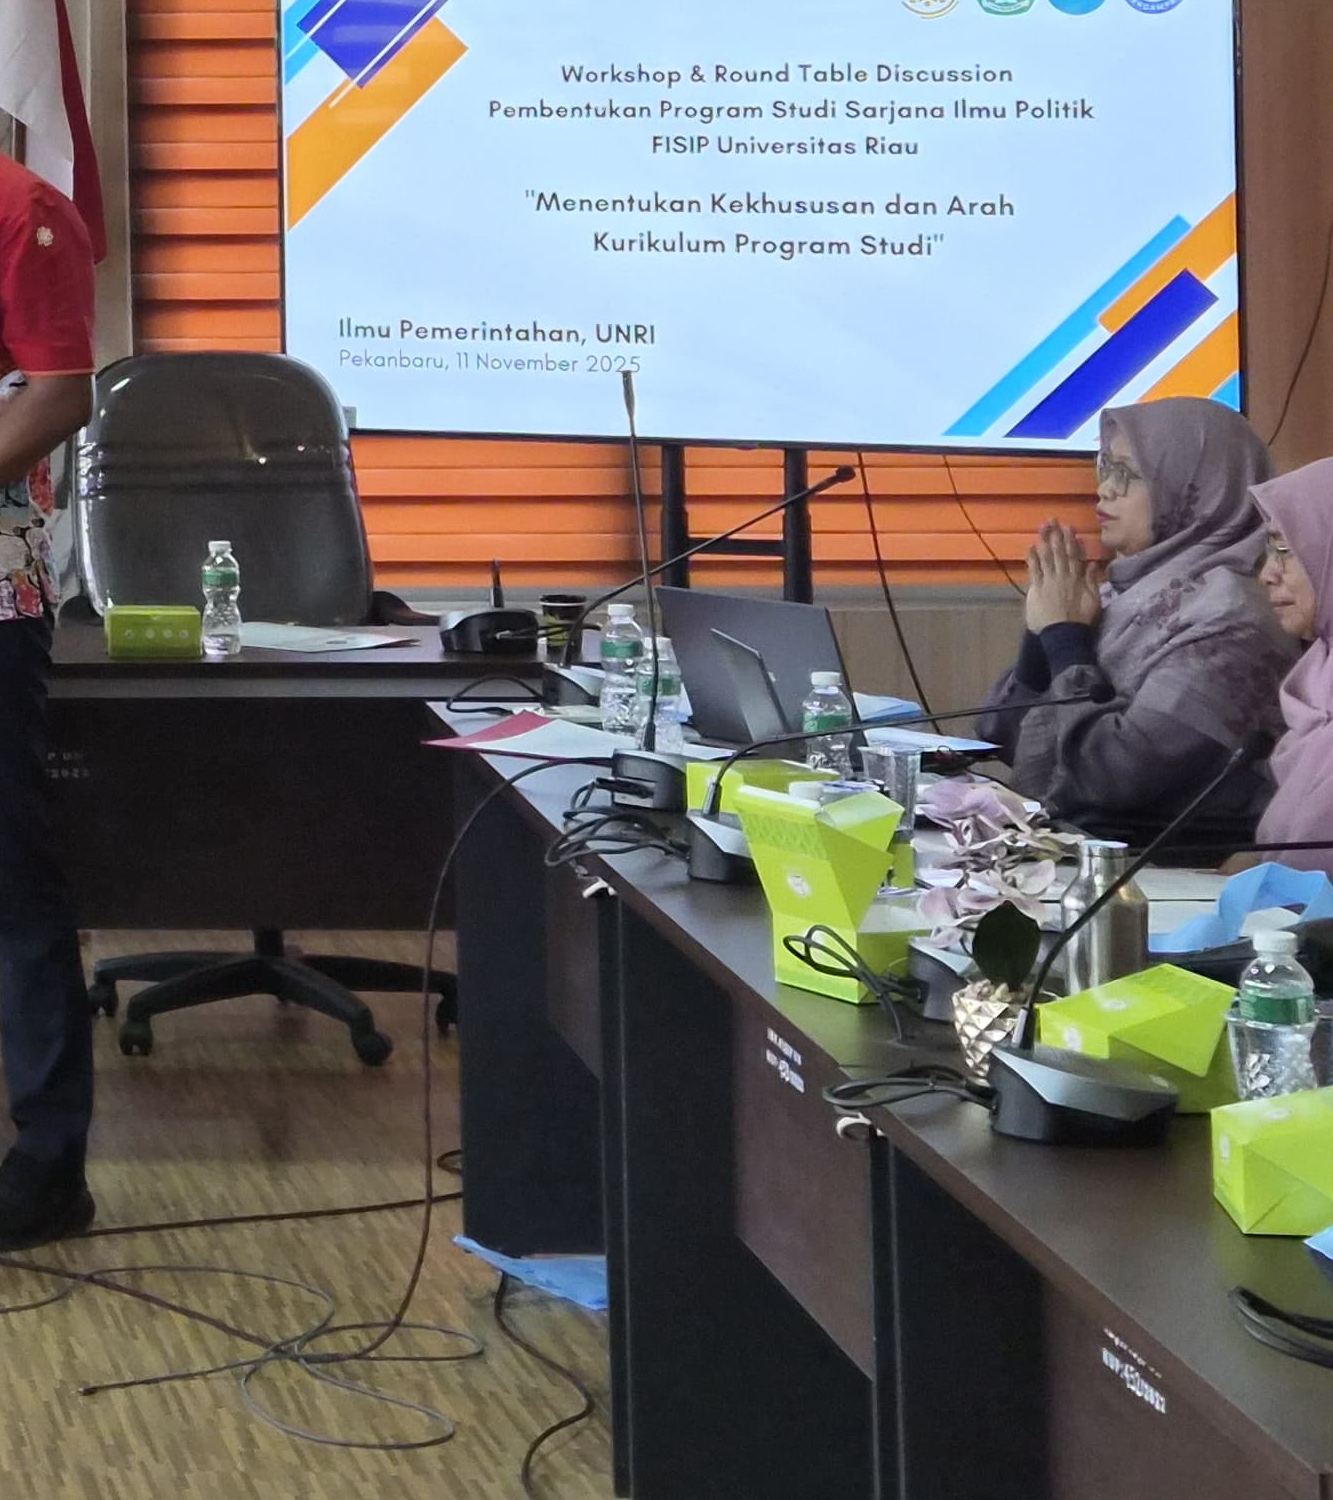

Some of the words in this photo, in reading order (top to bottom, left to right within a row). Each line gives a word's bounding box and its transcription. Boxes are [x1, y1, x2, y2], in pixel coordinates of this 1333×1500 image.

[561, 63, 681, 88] Workshop
[690, 64, 707, 83] &
[715, 62, 790, 83] Round
[798, 62, 868, 83] Table
[876, 63, 1013, 83] Discussion
[489, 98, 651, 119] Pembentukan
[660, 99, 763, 124] Program
[772, 98, 836, 119] Studi
[845, 99, 945, 125] Sarjana
[954, 98, 1007, 119] Ilmu
[1016, 98, 1096, 119] Politik
[652, 136, 710, 154] FISIP
[717, 136, 857, 155] Universitas
[865, 136, 919, 155] Riau
[525, 189, 702, 213] "Menentukan
[711, 191, 876, 214] Kekhususan
[885, 193, 937, 215] dan
[946, 194, 1014, 216] Arah
[593, 231, 726, 253] Kurikulum
[735, 233, 851, 261] Program
[860, 233, 945, 255] Studi"
[339, 317, 391, 338] Ilmu
[400, 319, 586, 346] Pemerintahan,
[595, 323, 655, 345] UNRI
[339, 349, 449, 371] Pekanbaru,
[456, 352, 469, 369] 11
[476, 352, 579, 372] November
[587, 355, 641, 373] 2025
